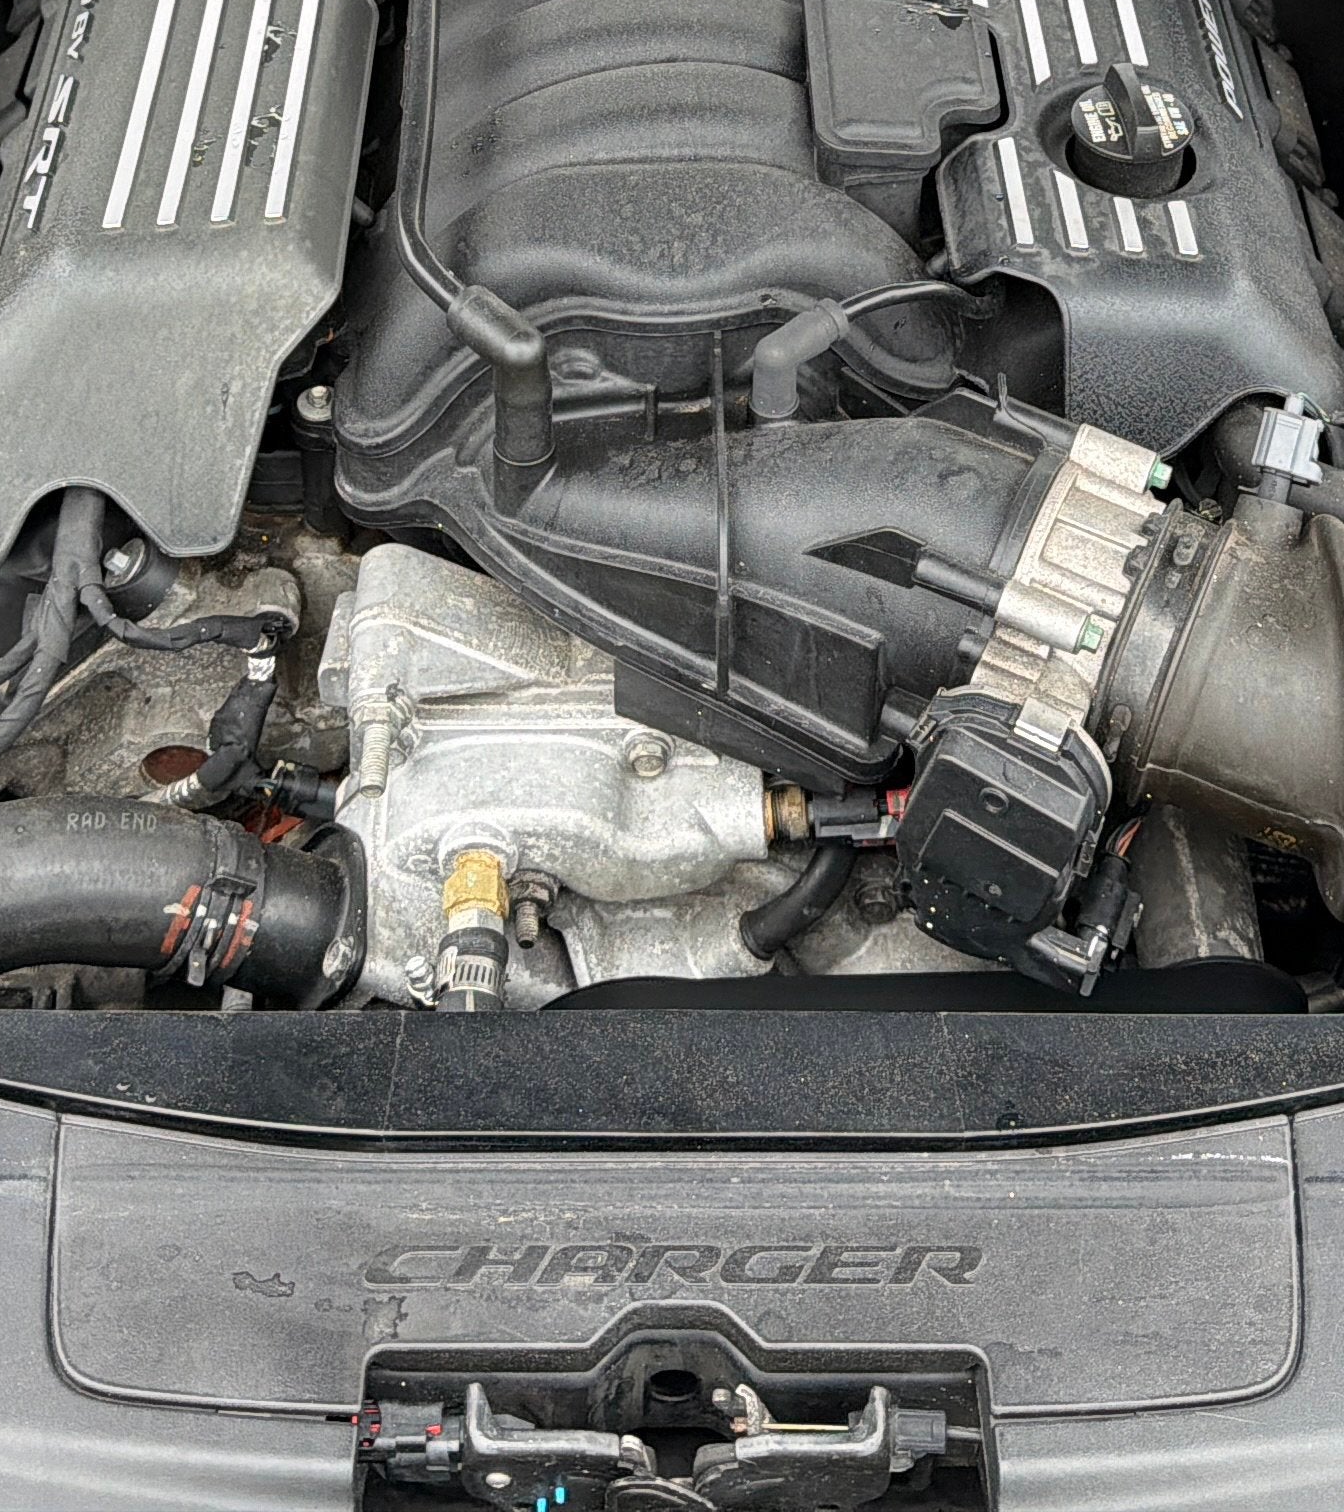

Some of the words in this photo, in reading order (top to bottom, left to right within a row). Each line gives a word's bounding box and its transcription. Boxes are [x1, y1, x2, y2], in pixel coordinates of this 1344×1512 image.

[66, 11, 91, 60] BY
[1078, 98, 1095, 112] OIL
[1084, 111, 1107, 143] ENGINE
[23, 73, 75, 229] SRT
[65, 811, 106, 831] RAD
[120, 812, 158, 831] END
[363, 1243, 985, 1288] CHARGER
